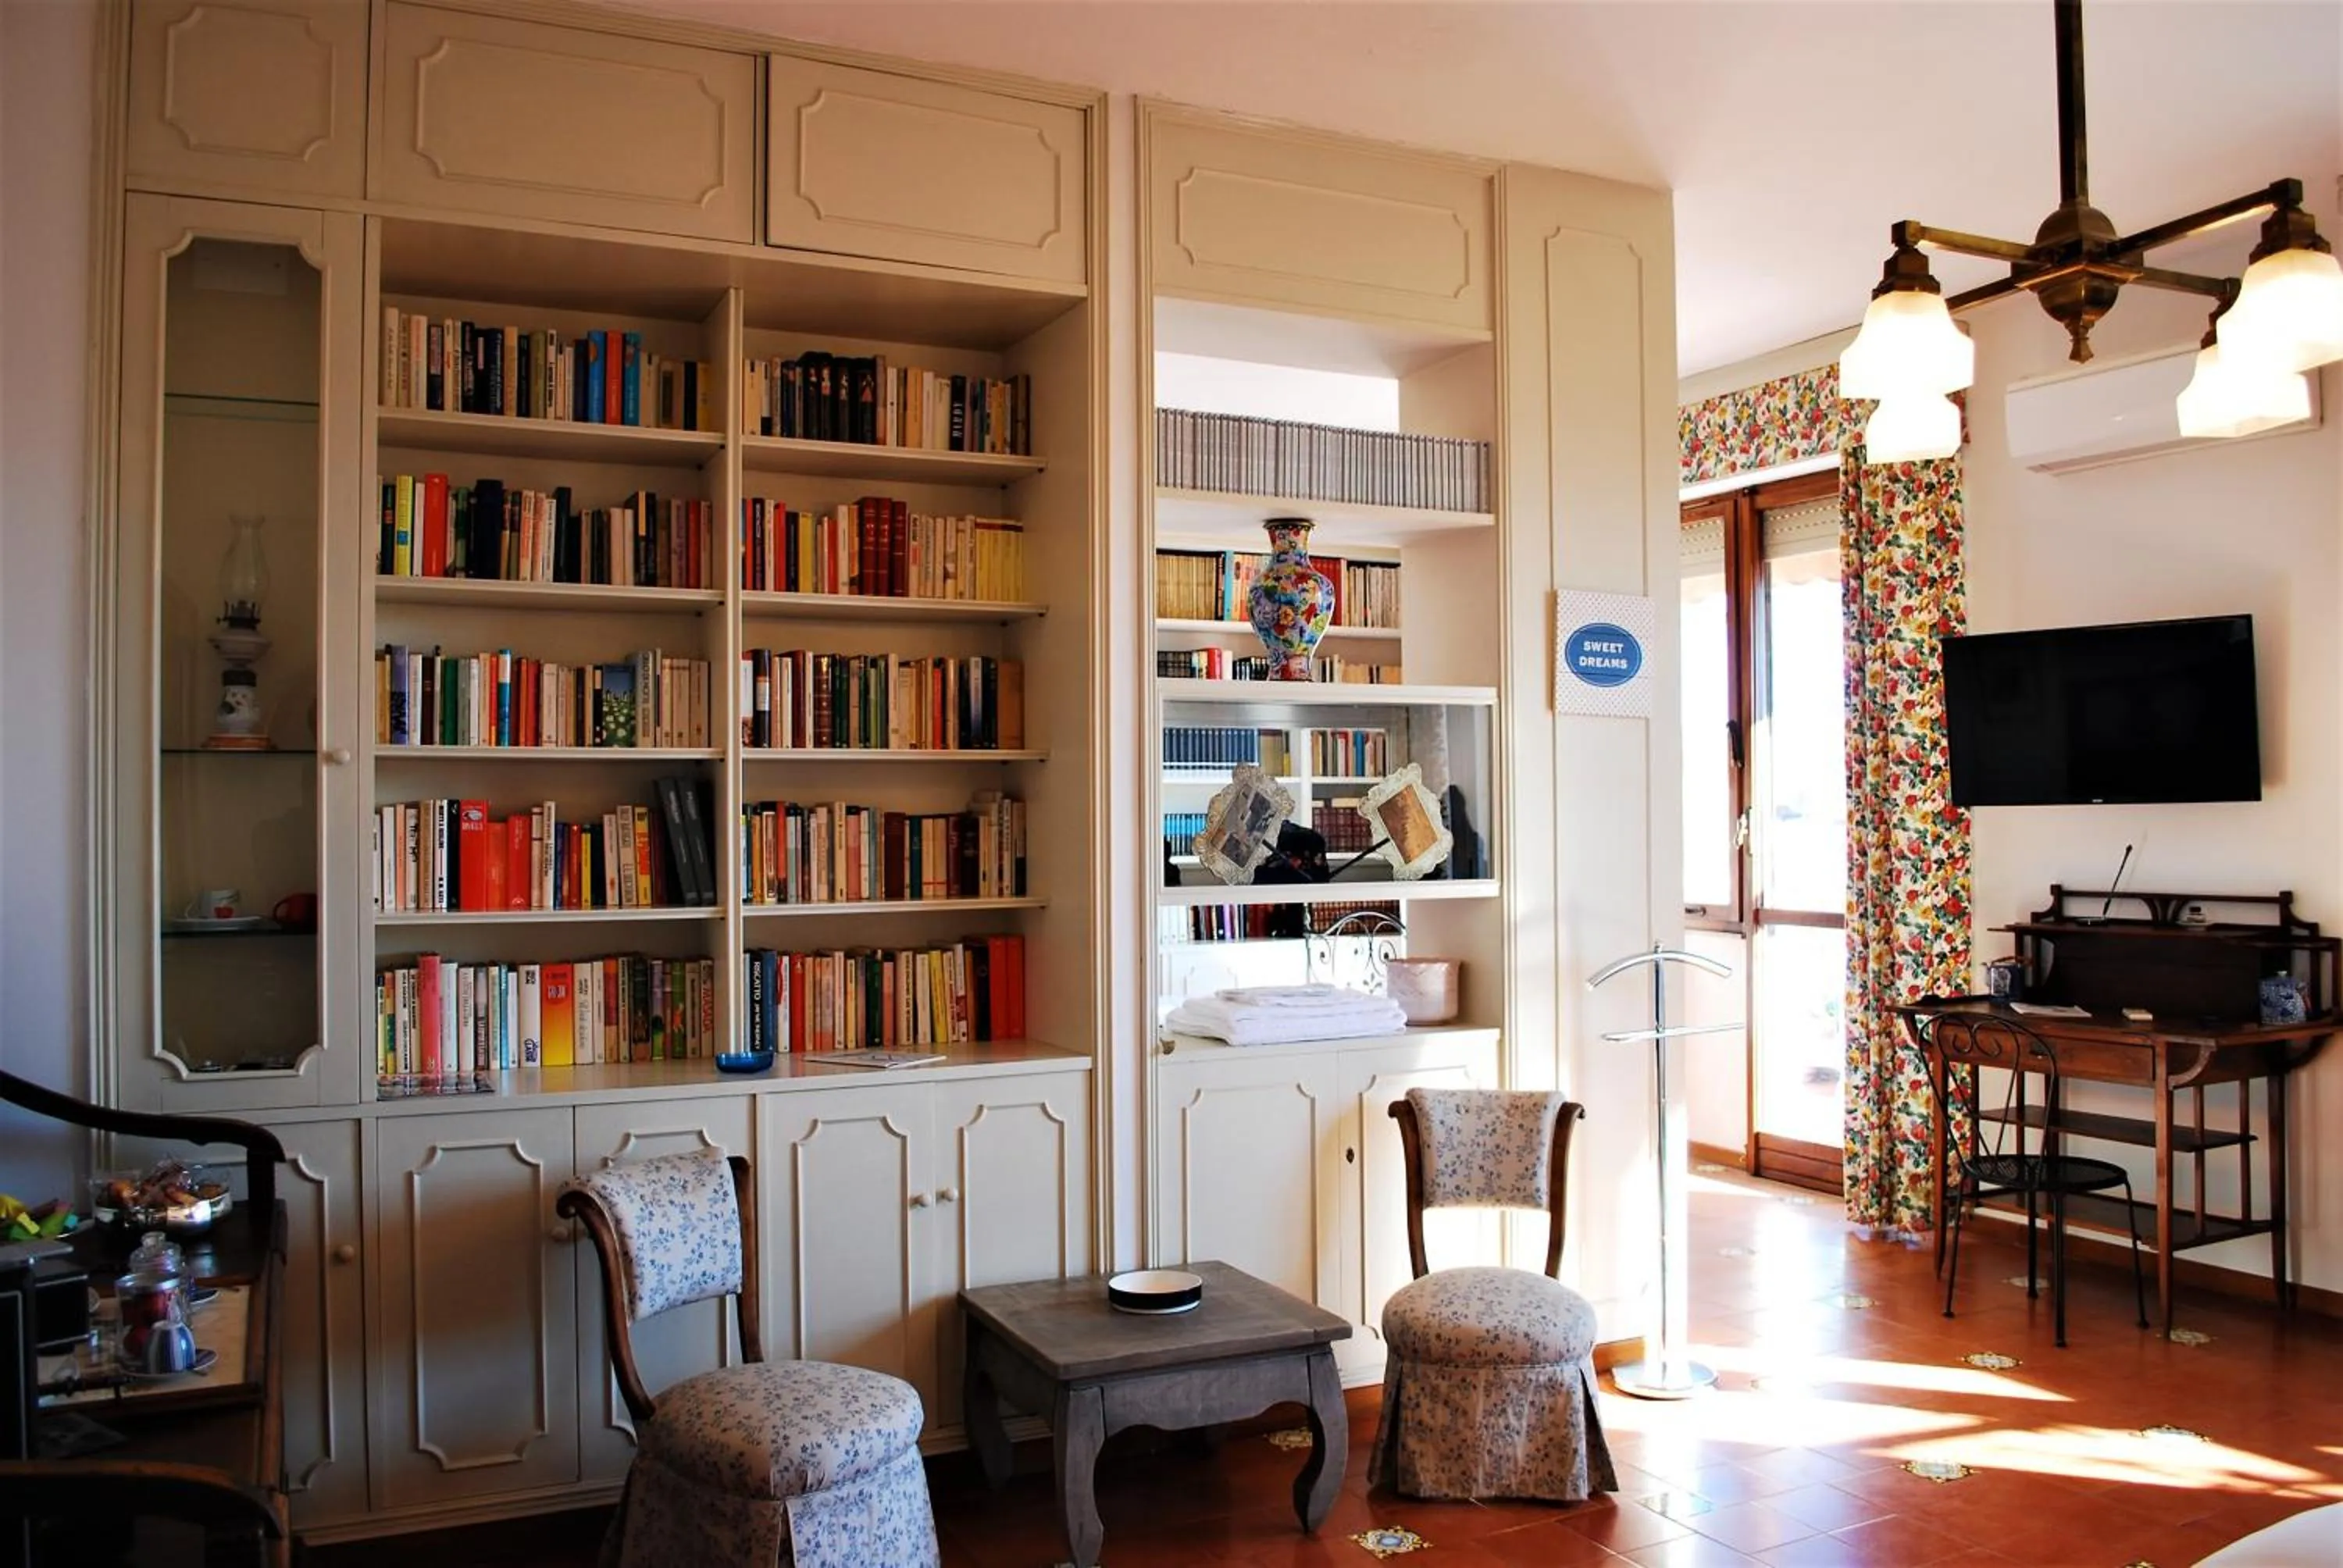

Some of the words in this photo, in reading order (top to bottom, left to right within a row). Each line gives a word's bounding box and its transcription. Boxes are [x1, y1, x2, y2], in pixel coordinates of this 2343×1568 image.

[1583, 641, 1624, 654] SWEET
[1578, 656, 1628, 669] DREAMS
[753, 961, 761, 1000] RISCATTO
